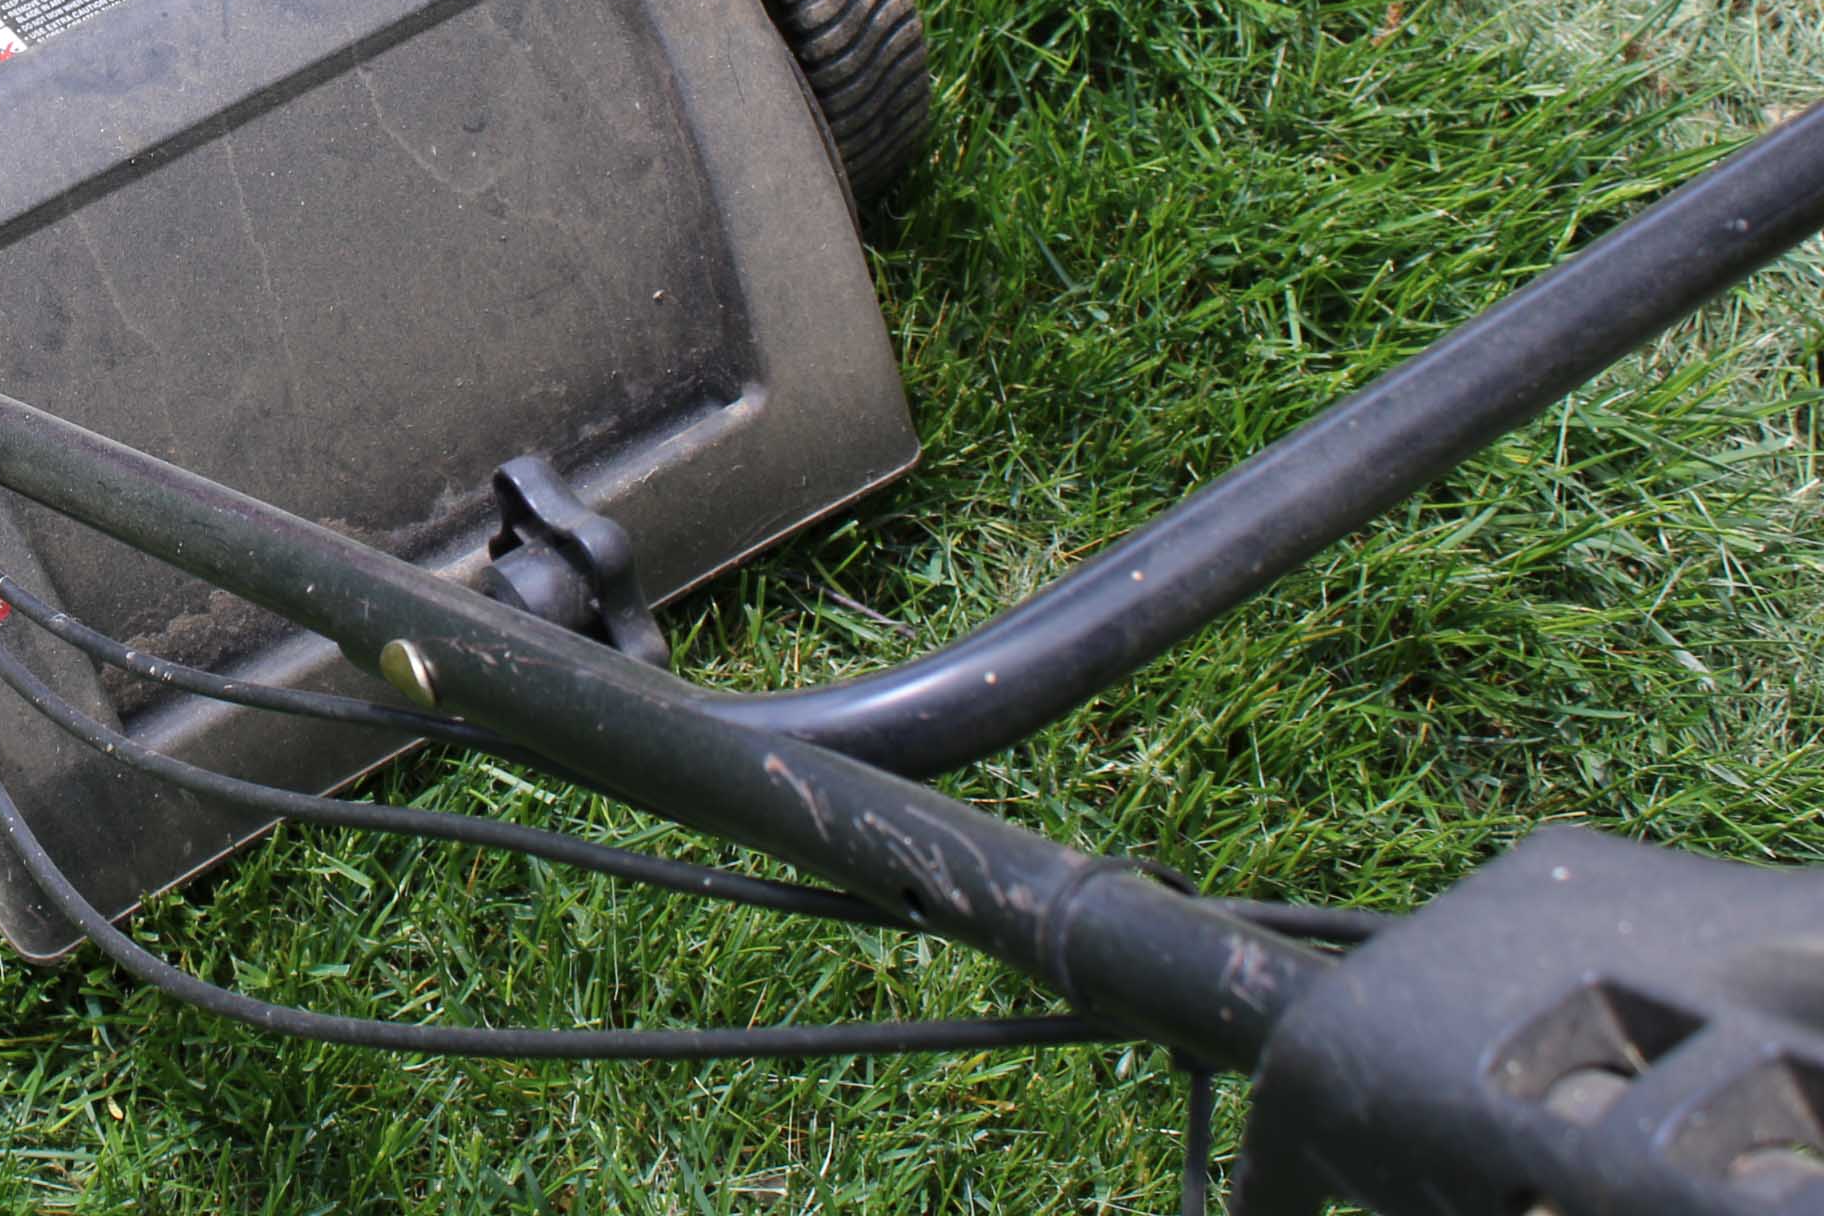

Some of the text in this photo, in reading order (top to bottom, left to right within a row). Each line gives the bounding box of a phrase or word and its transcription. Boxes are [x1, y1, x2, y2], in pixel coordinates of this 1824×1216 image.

[6, 0, 40, 17] REMOVE
[14, 7, 42, 23] BLADE
[39, 3, 51, 11] IN
[19, 22, 33, 31] DO
[30, 15, 47, 26] NOT
[44, 7, 64, 20] MOW
[27, 27, 47, 39] USE
[43, 14, 73, 31] EXTRA
